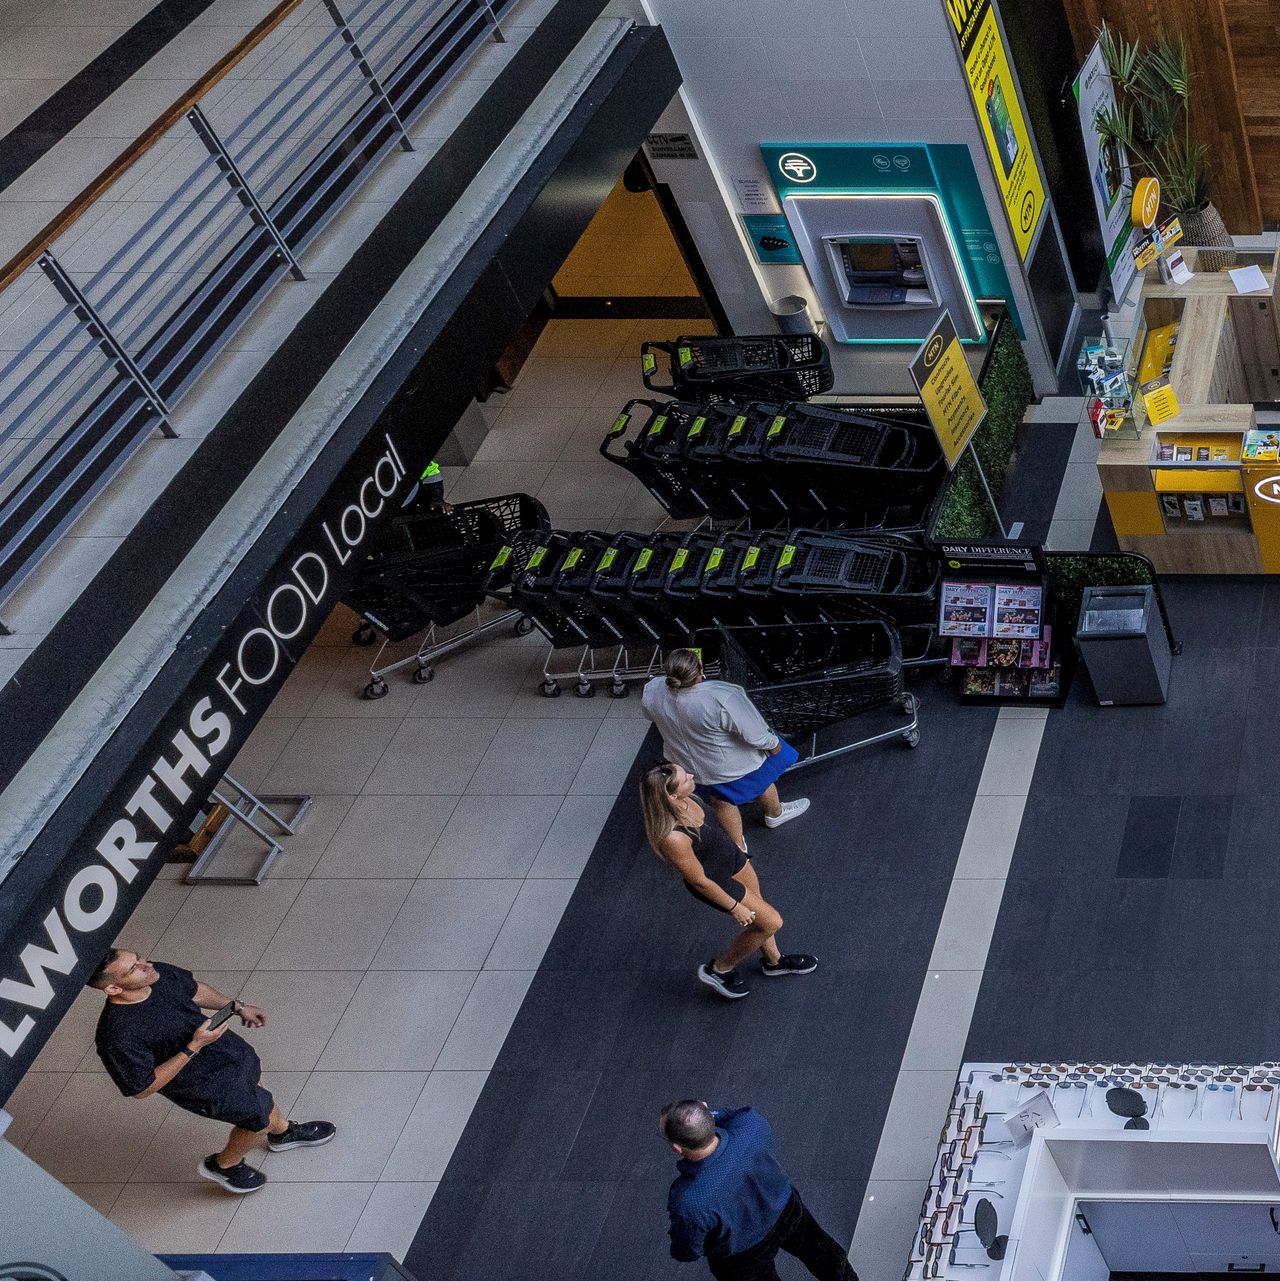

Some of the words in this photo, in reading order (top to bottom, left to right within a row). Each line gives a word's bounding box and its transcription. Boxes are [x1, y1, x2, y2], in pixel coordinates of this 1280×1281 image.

[1145, 188, 1157, 218] MTN
[926, 341, 940, 360] MTN
[931, 356, 951, 385] Contracts
[935, 366, 954, 396] Upgrades
[942, 545, 968, 553] DAILY
[970, 546, 1032, 555] DIFFERENCE
[215, 550, 330, 716] FOOD
